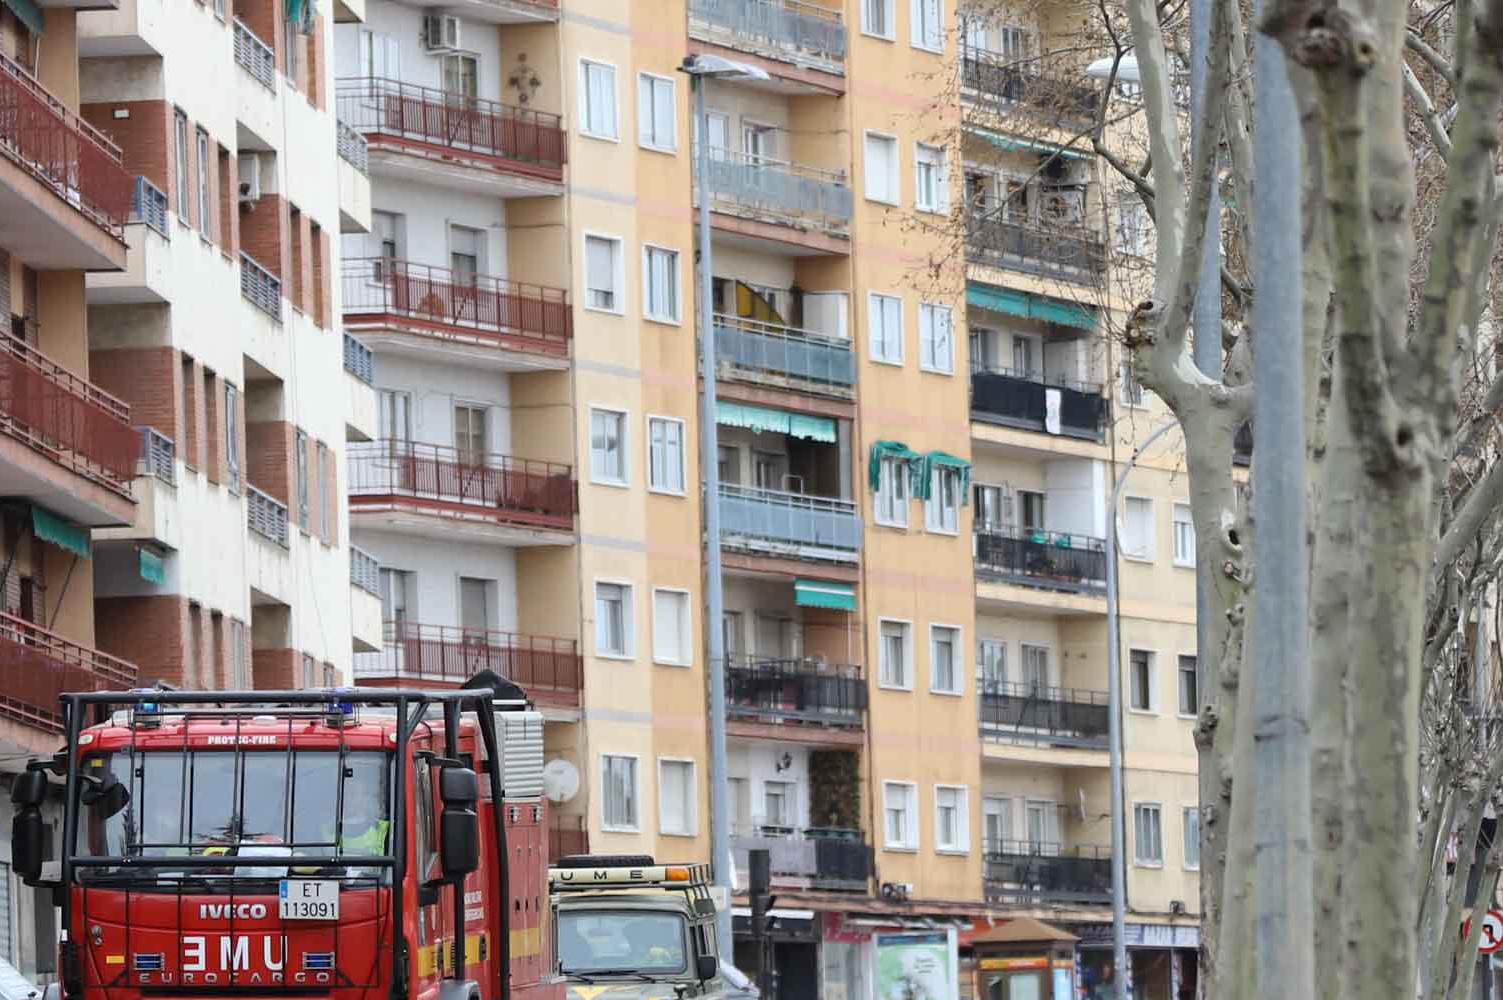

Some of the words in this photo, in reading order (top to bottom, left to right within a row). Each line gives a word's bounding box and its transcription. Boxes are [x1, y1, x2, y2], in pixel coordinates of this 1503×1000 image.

[560, 871, 644, 881] UME
[302, 882, 323, 897] ET
[200, 903, 268, 919] IVECO
[283, 902, 337, 917] 113091
[139, 972, 330, 983] EUROCARGO
